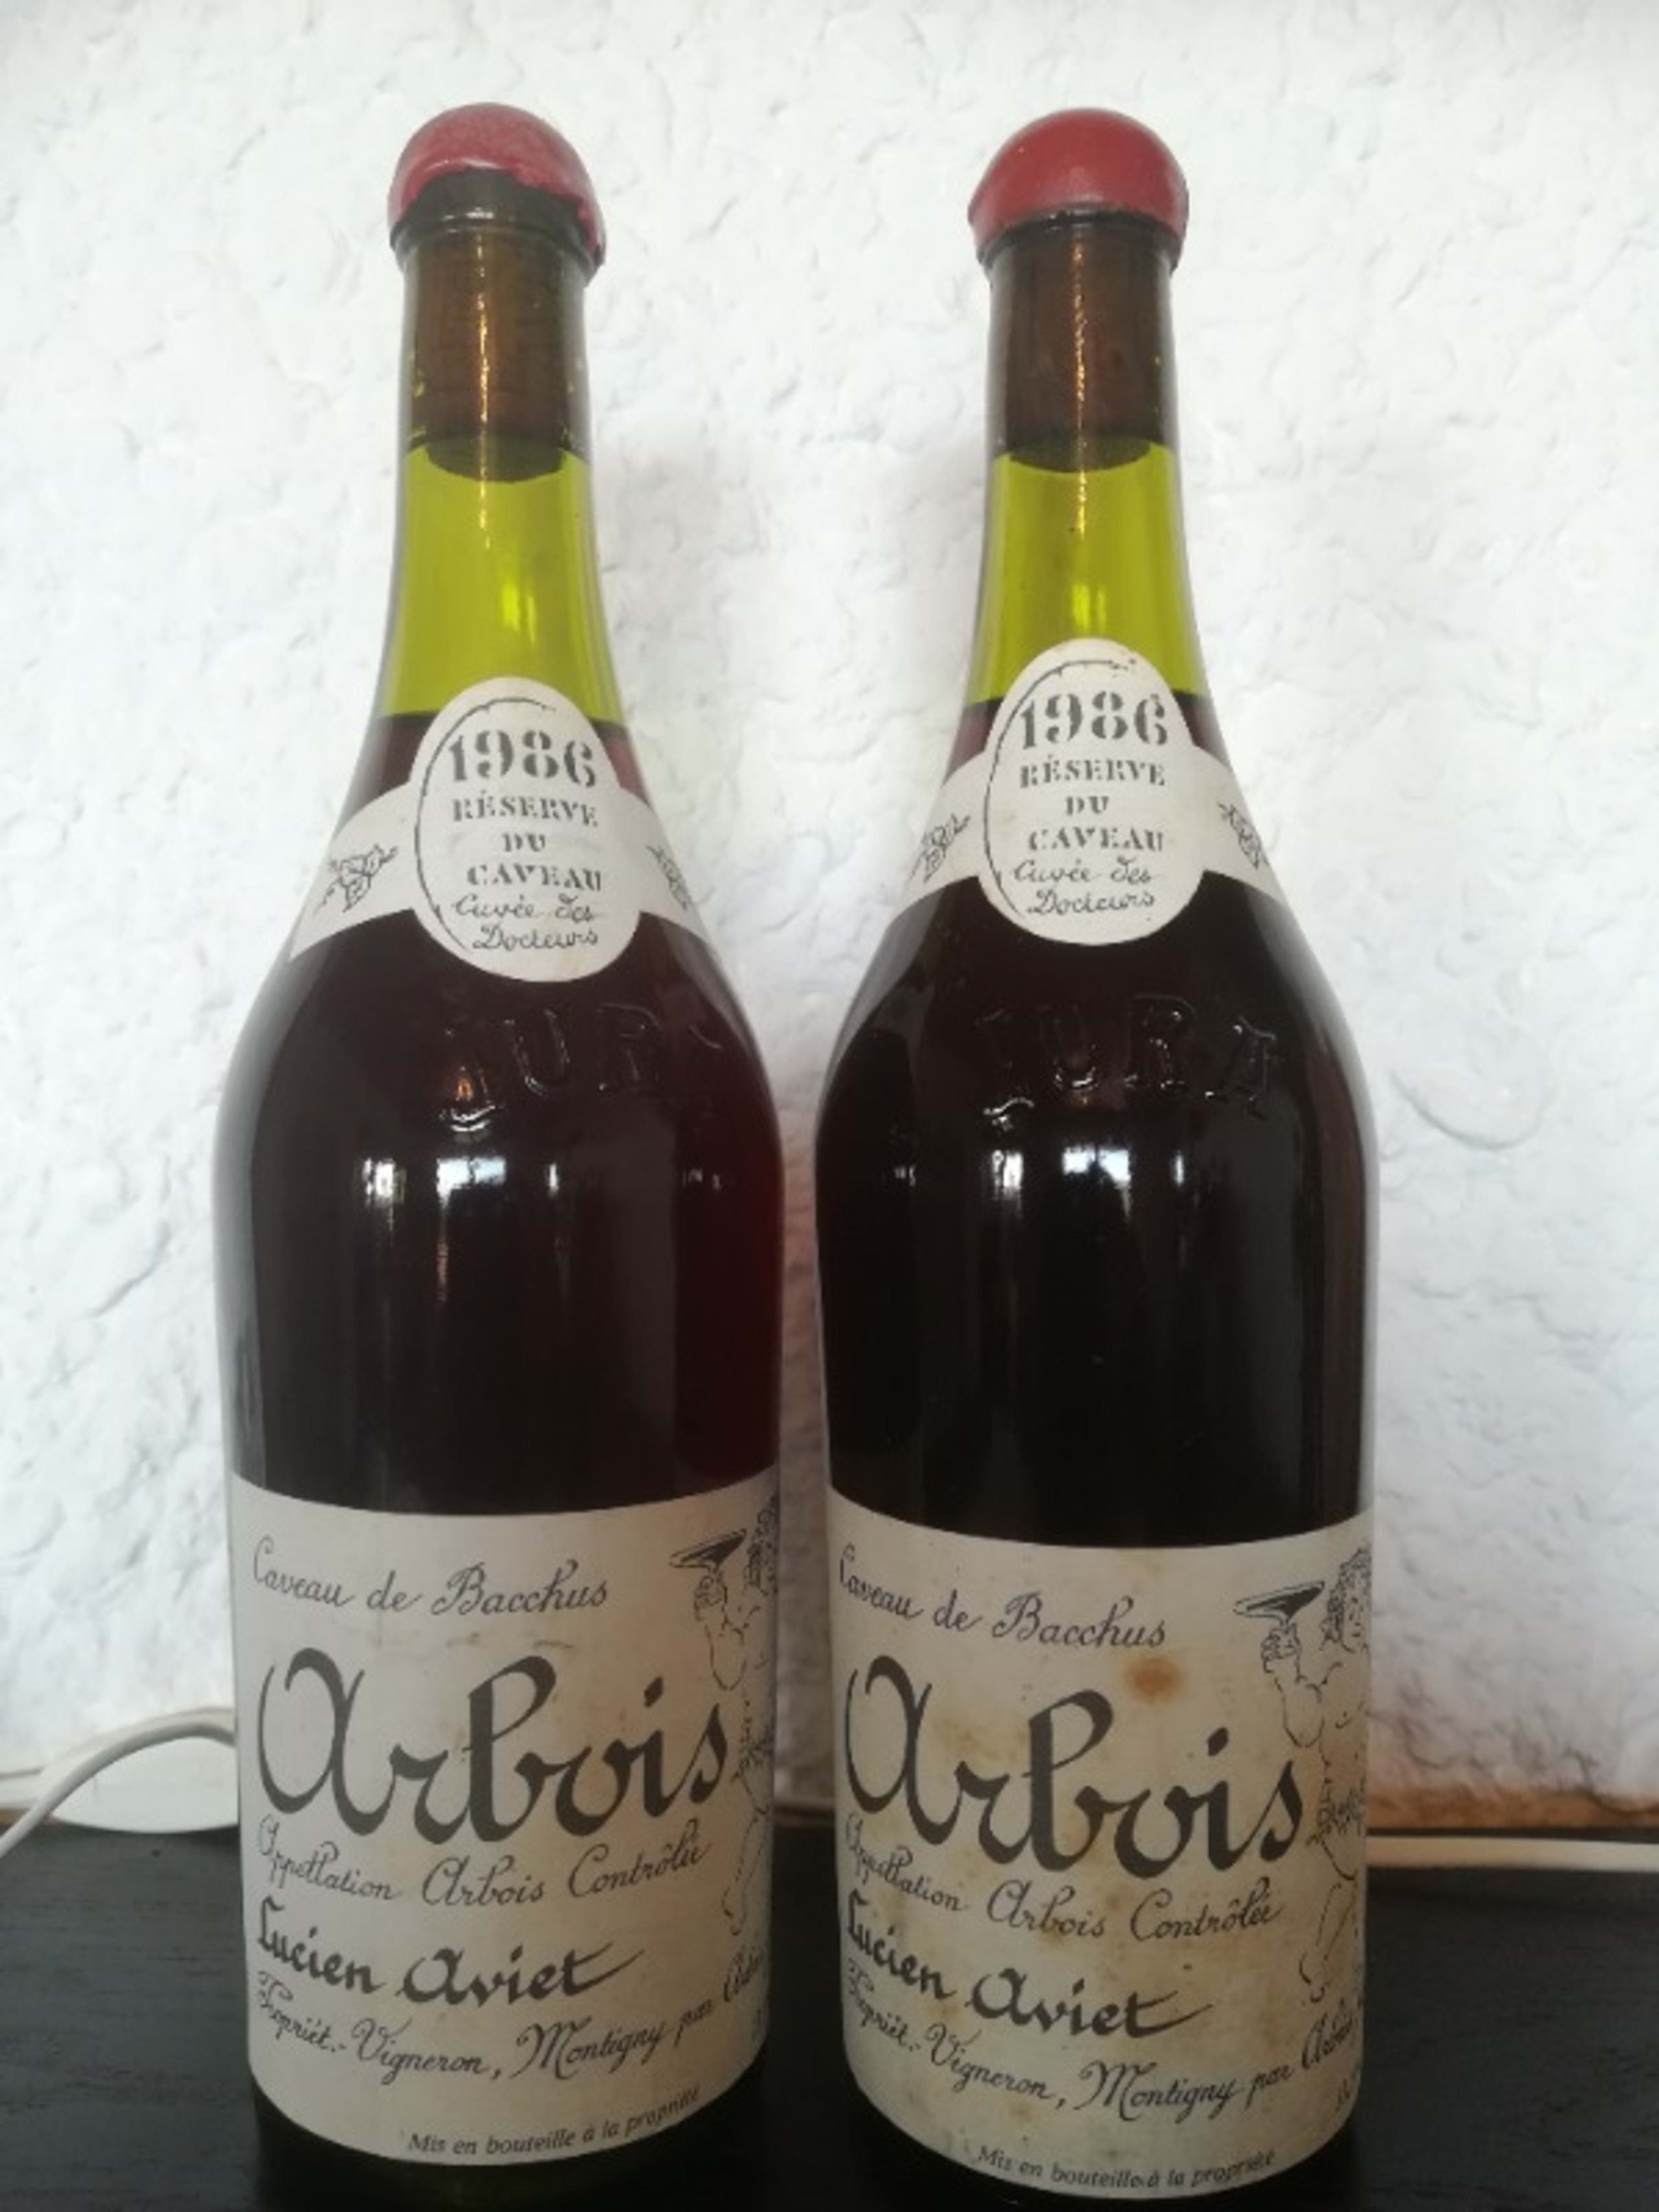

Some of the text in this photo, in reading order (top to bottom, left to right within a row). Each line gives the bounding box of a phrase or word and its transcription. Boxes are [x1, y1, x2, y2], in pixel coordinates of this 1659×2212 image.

[1019, 690, 1168, 751] 1986
[448, 730, 596, 787] 1986
[1019, 754, 1166, 788] RÉSERVE
[452, 789, 598, 828] RÉSERVE
[1065, 795, 1111, 817] DU
[502, 833, 547, 854] DU
[1027, 826, 1164, 853] CAVEAU
[466, 864, 602, 892] CAVEAU
[1014, 855, 1154, 886] Cuvée des
[453, 892, 535, 919] Cuvée
[1027, 887, 1157, 916] Docteurs
[472, 922, 599, 953] Docteurs
[253, 1535, 610, 1616] Caveau de Bacchus
[839, 1542, 1165, 1649] Caveau de Bacchus
[259, 1647, 728, 1846] Arbois
[845, 1656, 1305, 1878] Arbois
[421, 1843, 544, 1907] Arbois
[986, 1879, 1106, 1939] Arbois
[257, 1897, 645, 2007] Lucien Aviet
[848, 1889, 1214, 2039] Lucien Aviet
[511, 2015, 675, 2080] Montigny
[1073, 2060, 1246, 2123] Montigny
[408, 2134, 446, 2153] Mis
[452, 2138, 477, 2155] en
[486, 2130, 576, 2155] bouteille
[602, 2119, 620, 2139] la
[977, 2146, 1013, 2171] Mis
[1019, 2160, 1043, 2178] en
[1168, 2171, 1187, 2186] la
